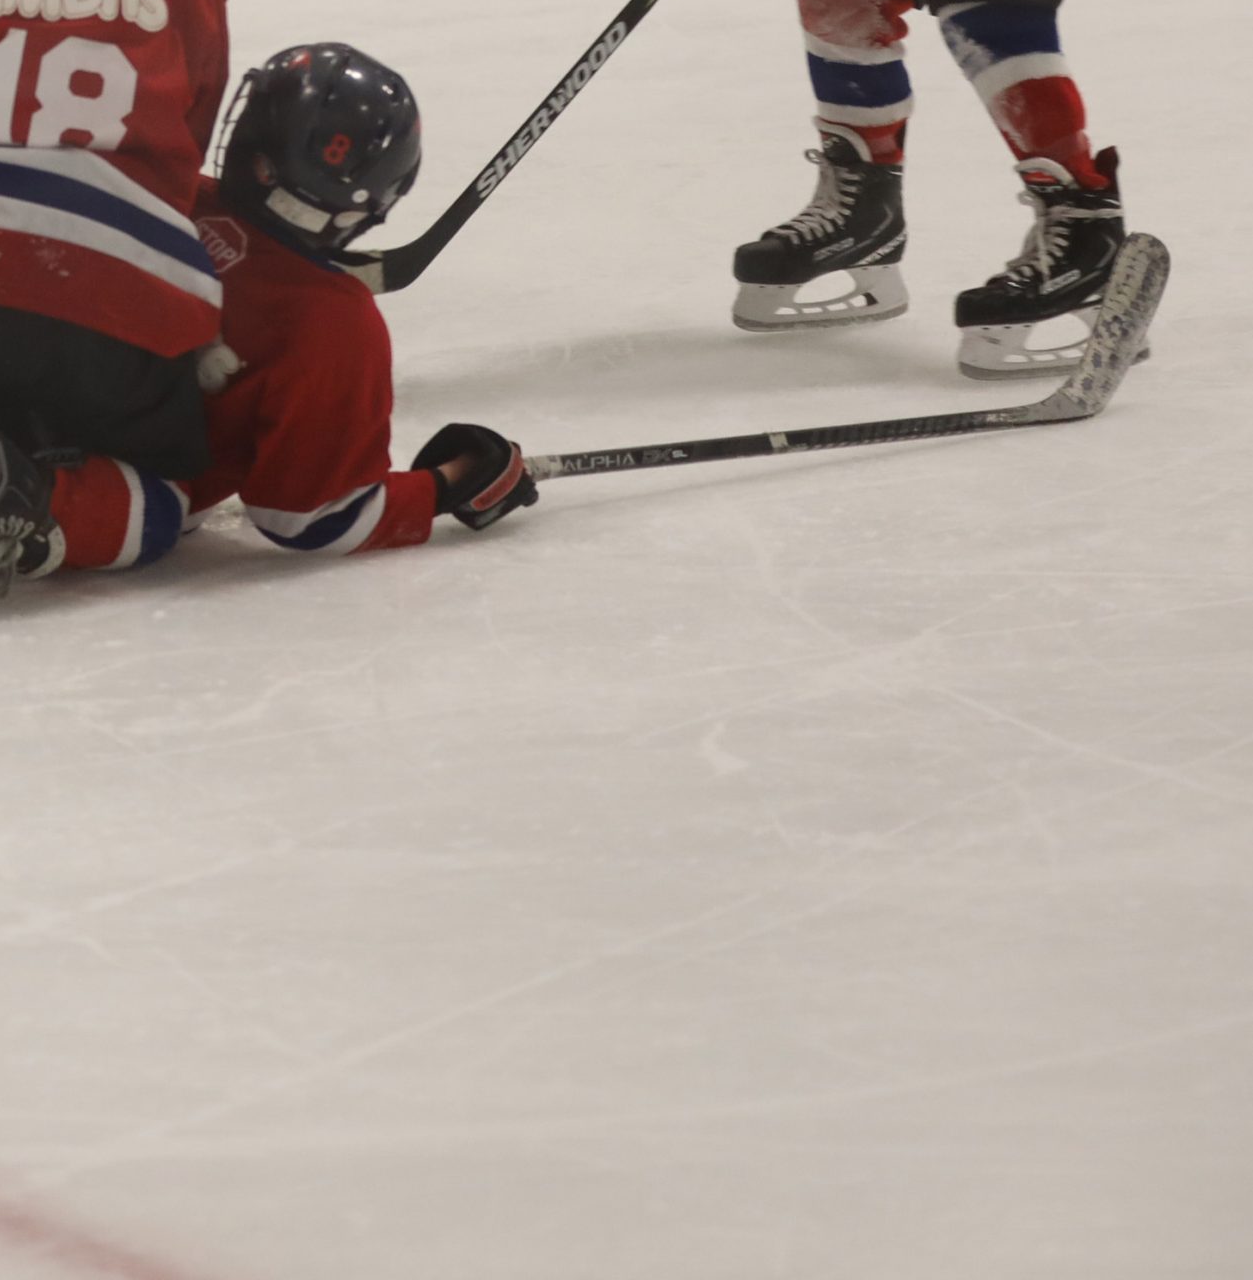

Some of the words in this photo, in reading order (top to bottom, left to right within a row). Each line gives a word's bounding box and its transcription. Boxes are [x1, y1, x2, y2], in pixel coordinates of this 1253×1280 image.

[475, 20, 628, 200] SHER-WOOD
[322, 132, 353, 167] 8
[562, 452, 636, 472] ALPHA
